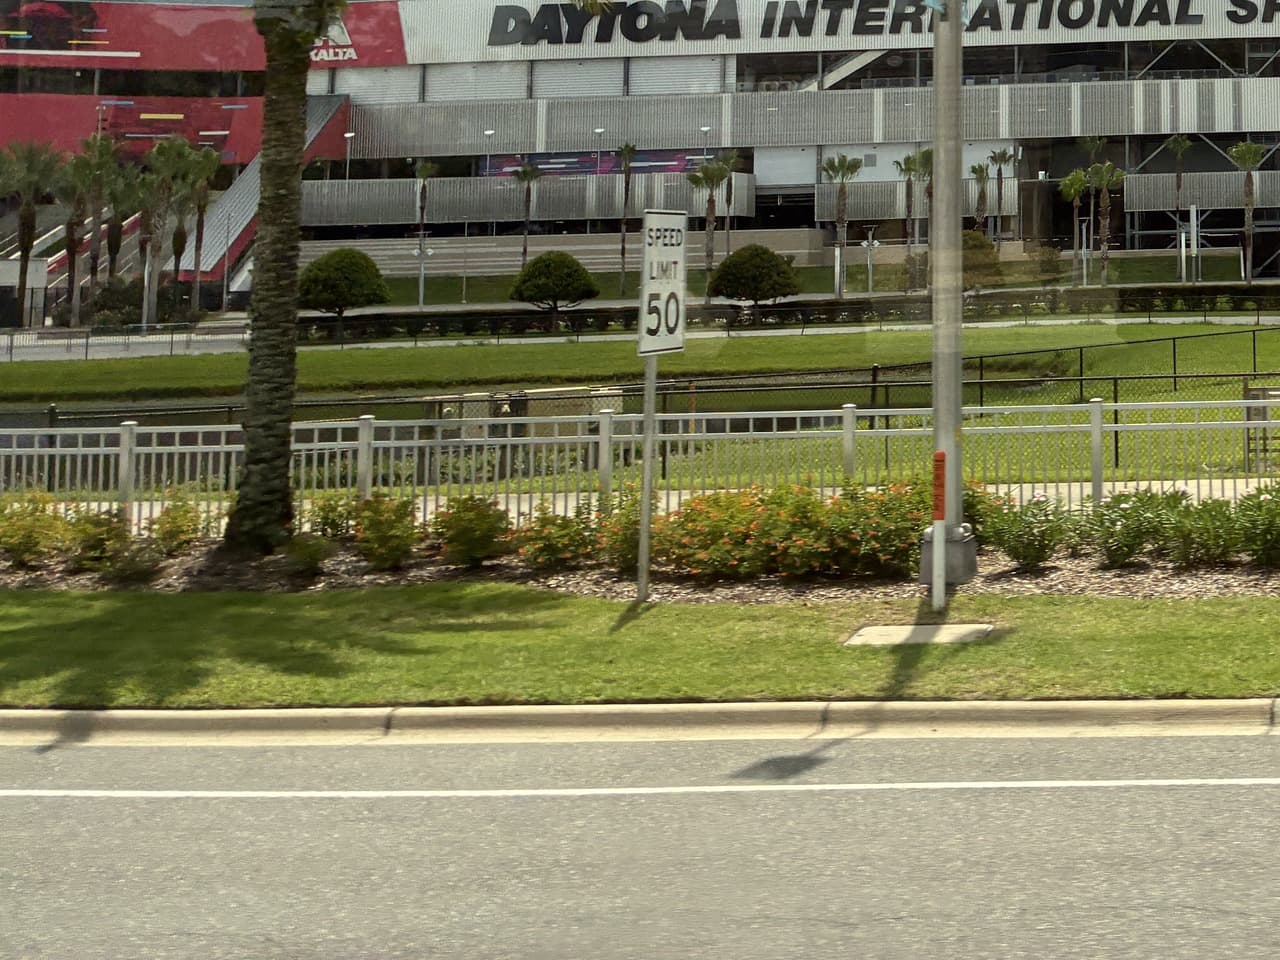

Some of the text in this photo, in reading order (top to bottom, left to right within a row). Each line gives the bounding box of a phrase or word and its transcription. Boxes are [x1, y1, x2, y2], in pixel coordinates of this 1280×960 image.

[309, 47, 358, 62] XALTA
[647, 227, 683, 247] SPEED
[649, 260, 679, 281] LIMIT
[646, 291, 680, 337] 50
